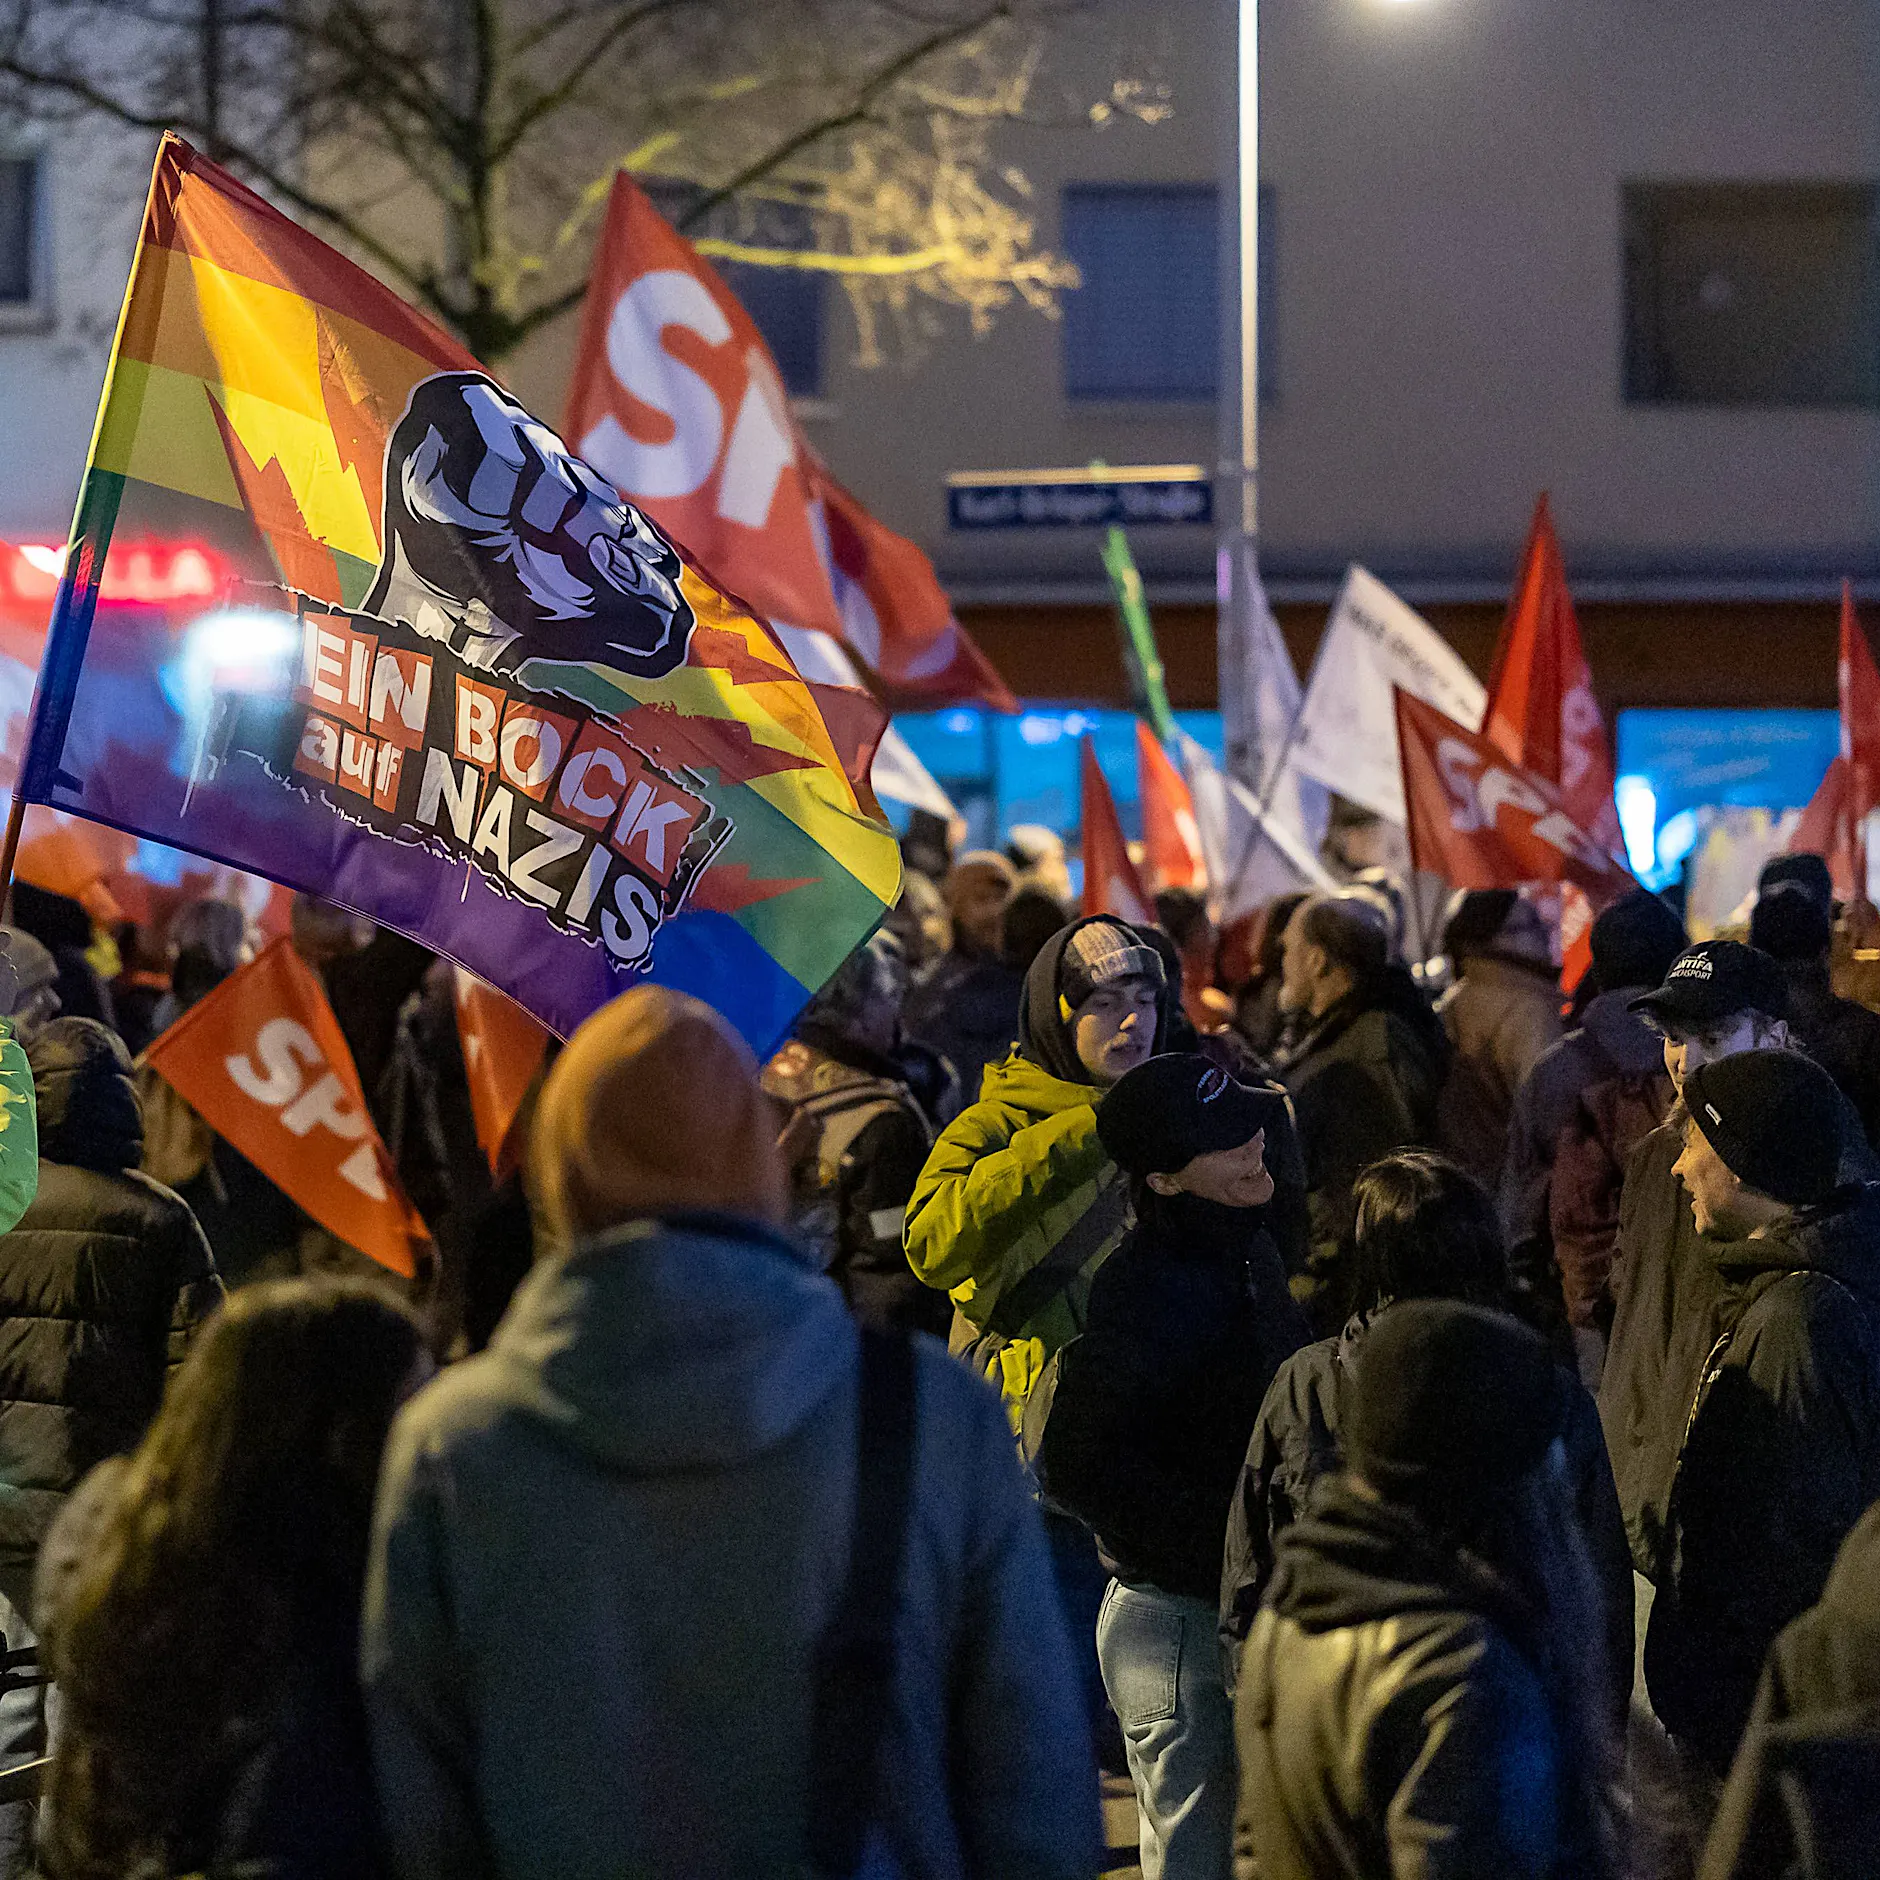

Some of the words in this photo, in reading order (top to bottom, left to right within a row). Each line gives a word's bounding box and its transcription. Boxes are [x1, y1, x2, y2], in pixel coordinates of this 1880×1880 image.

[300, 619, 432, 733] EIN
[455, 684, 691, 875] BOCK
[301, 717, 402, 797] auf
[416, 746, 660, 960] NAZIS
